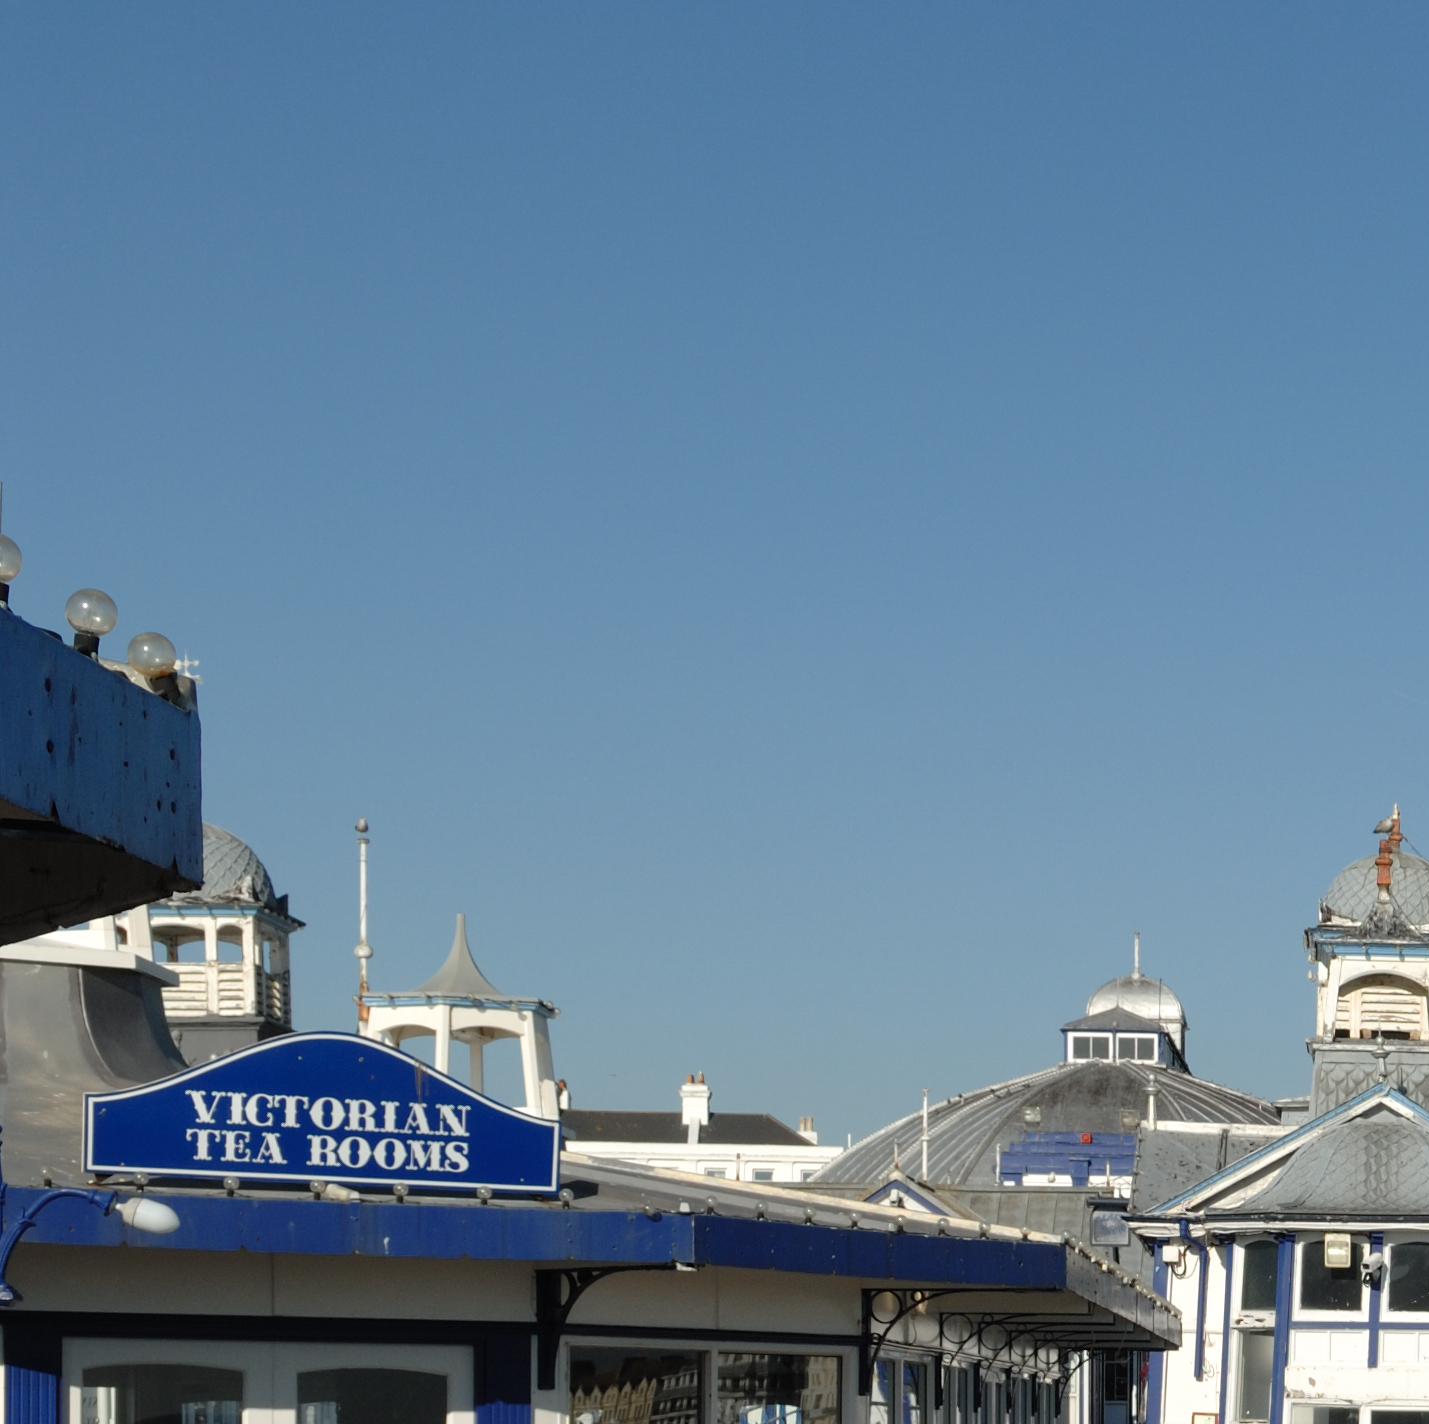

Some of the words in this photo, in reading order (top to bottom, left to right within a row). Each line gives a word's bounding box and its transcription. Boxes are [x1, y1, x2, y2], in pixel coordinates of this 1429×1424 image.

[185, 1089, 471, 1137] VICTORIAN
[185, 1128, 288, 1165] TEA
[306, 1134, 470, 1173] ROOMS
